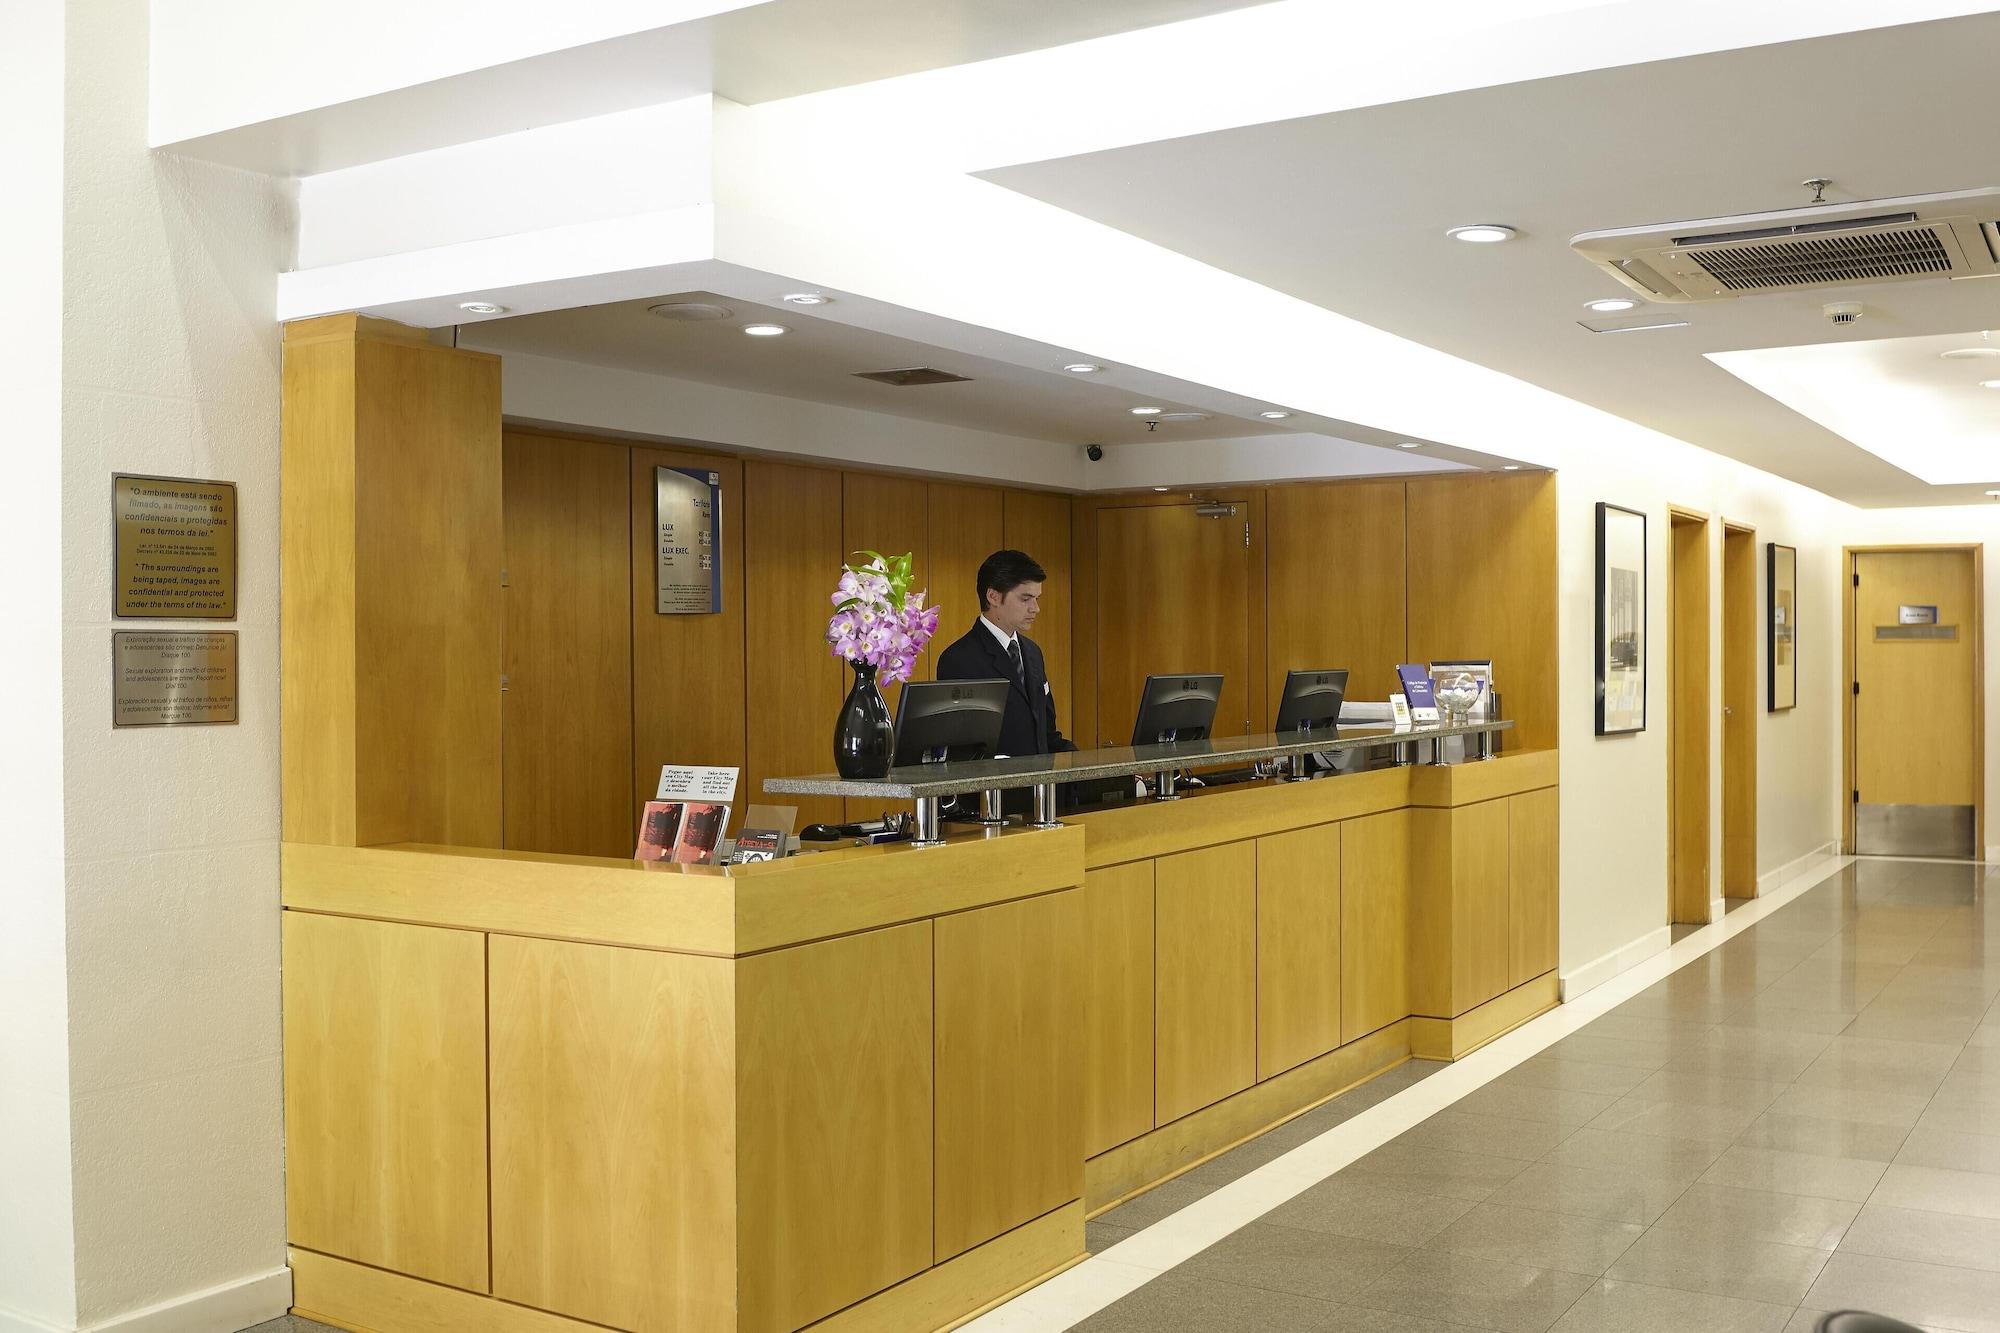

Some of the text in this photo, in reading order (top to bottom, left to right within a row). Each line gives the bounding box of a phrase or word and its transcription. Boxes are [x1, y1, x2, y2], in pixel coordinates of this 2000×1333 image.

[142, 489, 178, 498] ambiente
[129, 500, 161, 509] filmado,
[174, 502, 207, 512] imagens
[209, 504, 223, 513] são
[125, 513, 178, 523] confidenciais
[186, 515, 228, 526] protegidas
[140, 527, 155, 535] nos
[157, 528, 185, 536] termos
[187, 528, 196, 537] da
[156, 565, 206, 574] surroundings
[133, 576, 154, 585] being
[156, 577, 179, 585] taped,
[180, 577, 207, 585] images
[129, 588, 172, 596] confidential
[189, 589, 224, 598] protected
